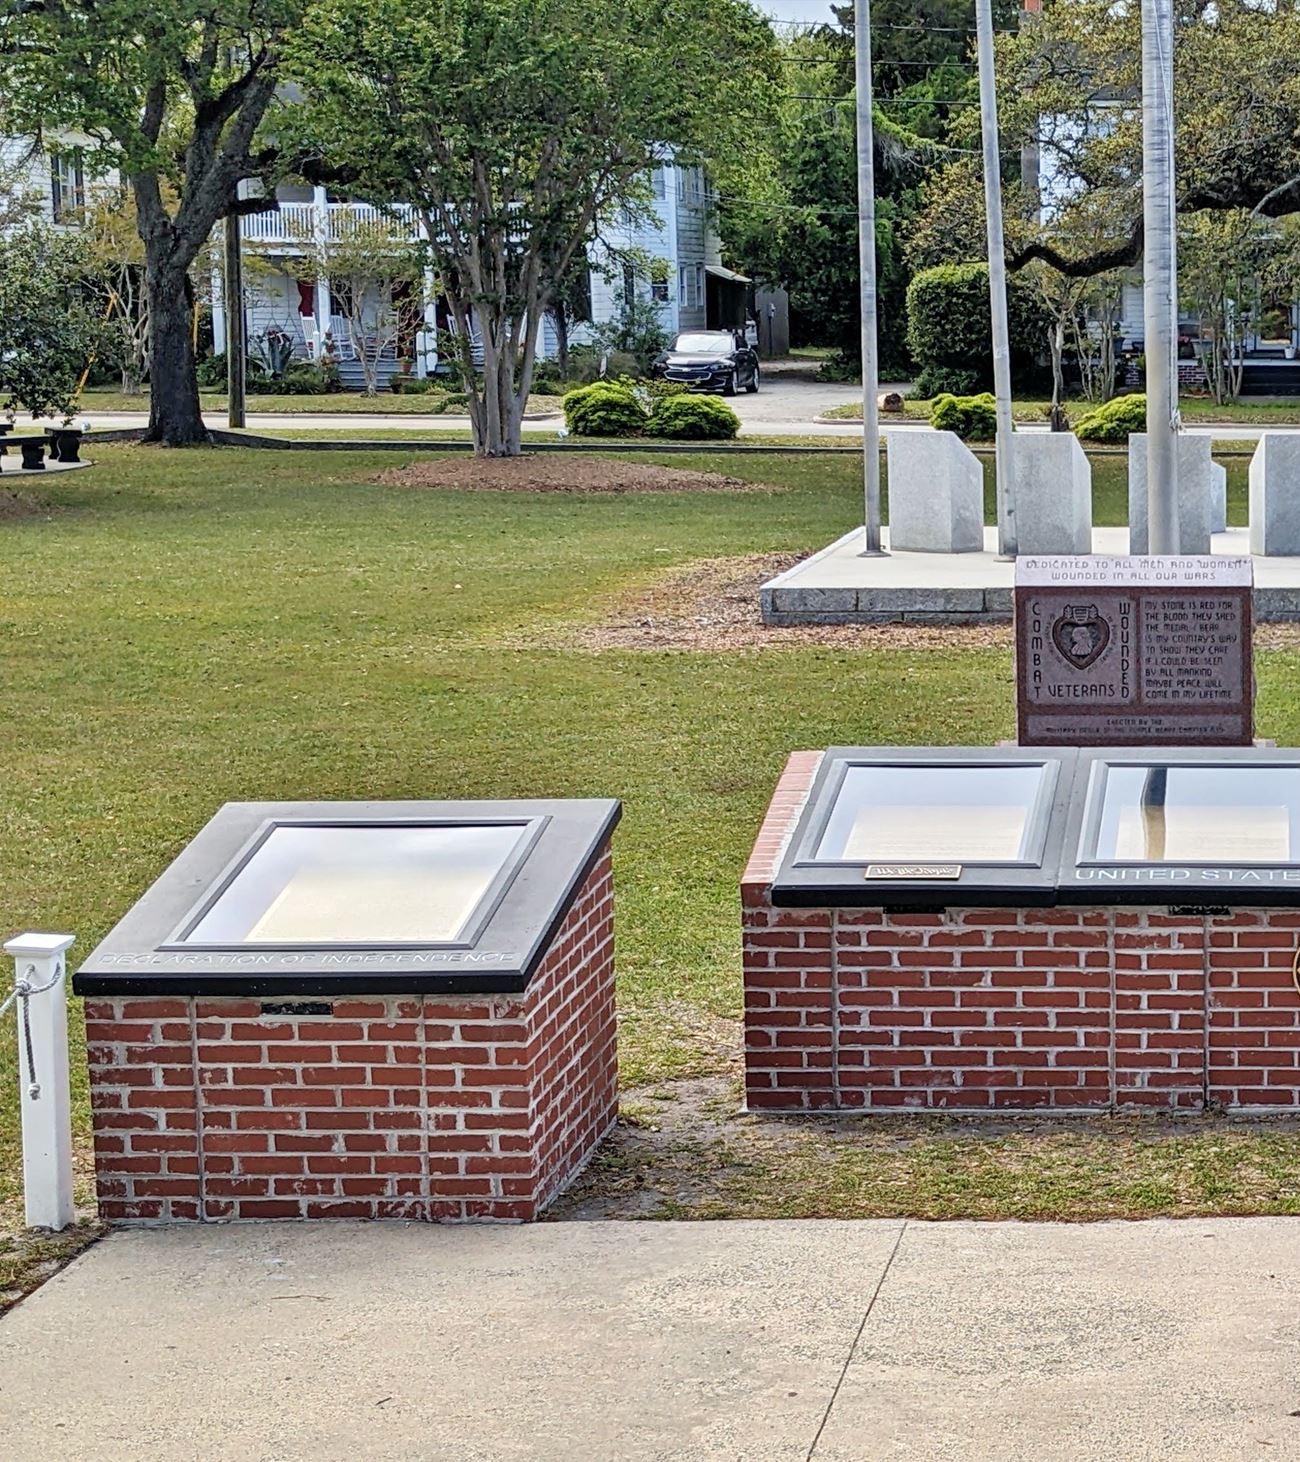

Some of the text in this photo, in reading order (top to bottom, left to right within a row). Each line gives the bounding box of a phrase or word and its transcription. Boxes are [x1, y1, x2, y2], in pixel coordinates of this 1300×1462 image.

[1026, 560, 1089, 569] DEDICATED
[1096, 560, 1108, 569] TO
[1115, 560, 1133, 569] ALL
[1140, 560, 1164, 569] MEN
[1171, 560, 1193, 569] AND
[1051, 572, 1216, 580] WOUNDED IN ALL OUR WARS
[1145, 601, 1233, 610] MY STONE IS RED FOR
[1145, 612, 1236, 621] THE BLOOD THEY SHED
[1145, 624, 1159, 632] THE
[1145, 634, 1152, 643] IS
[1156, 634, 1169, 643] MY
[1218, 634, 1237, 643] WAY
[1032, 602, 1043, 699] COMBAT
[1120, 602, 1130, 699] WOUNDED
[1145, 645, 1156, 654] TO
[1160, 645, 1181, 654] SHOW
[1185, 645, 1206, 654] THEY
[1145, 657, 1151, 666] IF
[1155, 657, 1159, 666] I
[1161, 657, 1187, 666] COULD
[1190, 657, 1199, 666] BE
[1145, 668, 1213, 677] BY ALL MANKIND
[1145, 679, 1223, 688] MAYBE PEACE WILL
[1048, 684, 1116, 697] VETERANS
[1145, 690, 1232, 699] COME IN MY LIFETIME
[1075, 869, 1190, 879] UNITED
[100, 952, 517, 964] DECLARATION OF INDEPENDENCE
